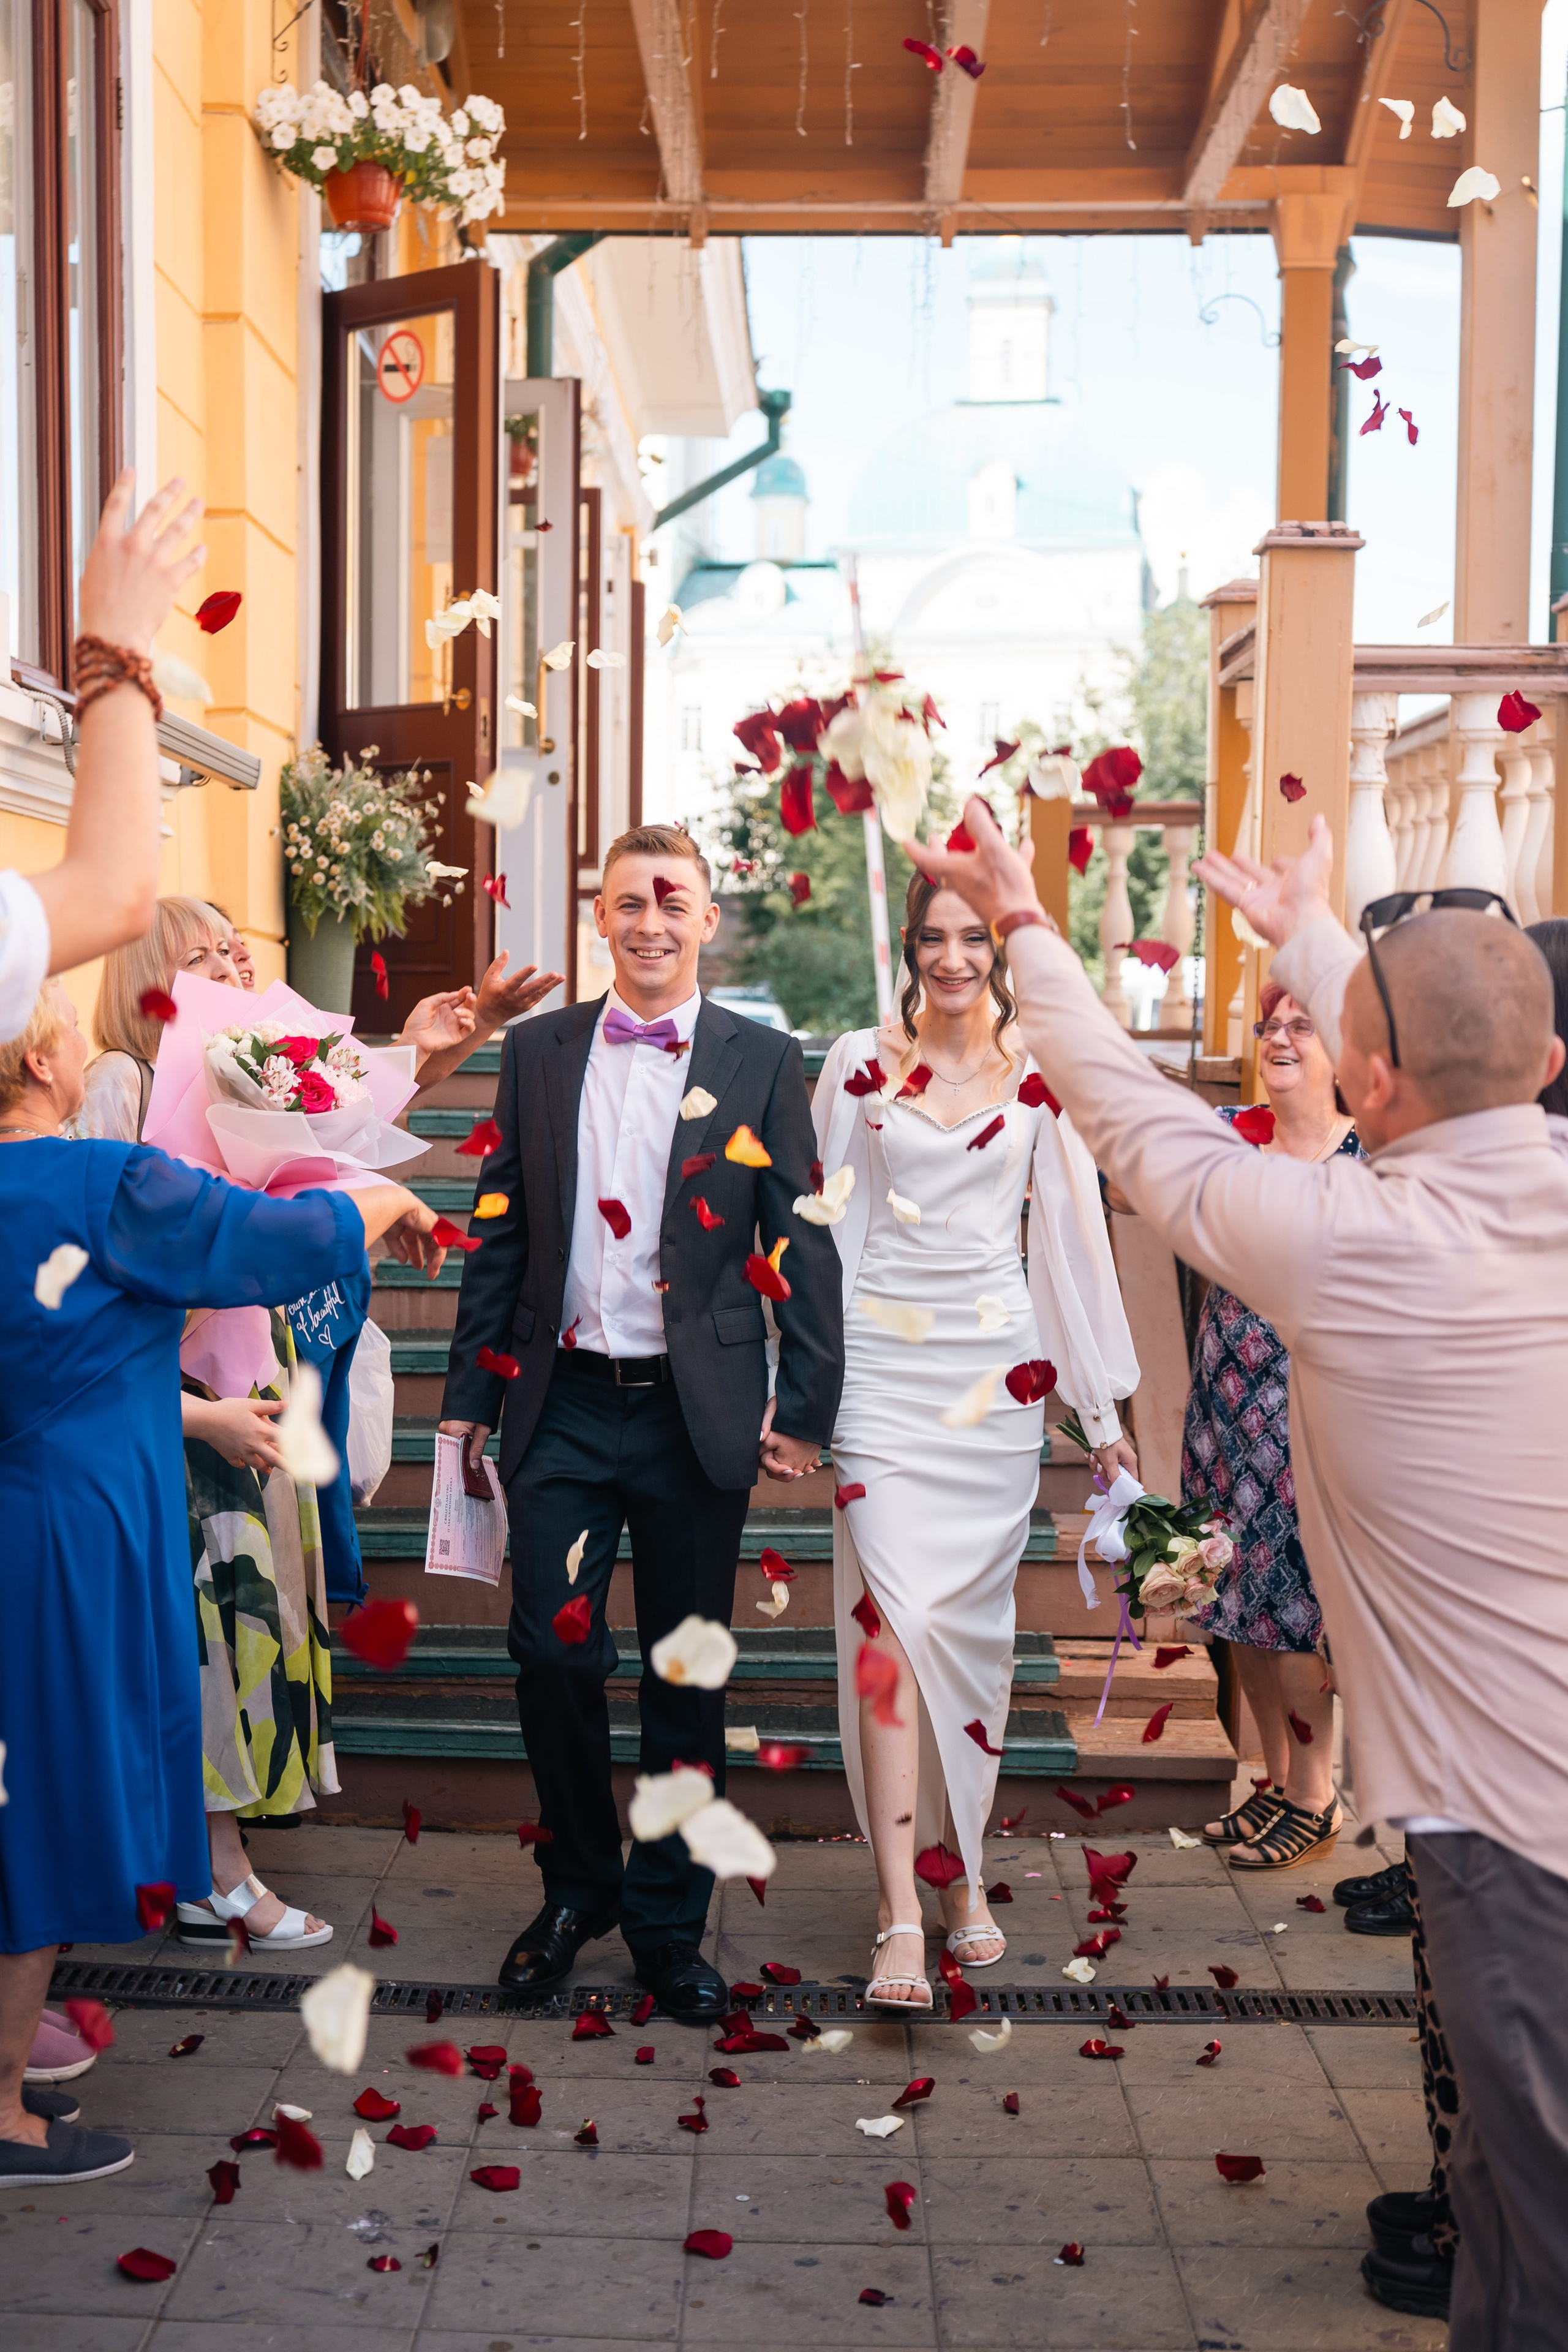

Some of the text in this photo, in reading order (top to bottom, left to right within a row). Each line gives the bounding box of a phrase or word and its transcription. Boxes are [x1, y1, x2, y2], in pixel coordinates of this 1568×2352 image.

[288, 1297, 307, 1316] own
[296, 1280, 345, 1343] of beautiful
